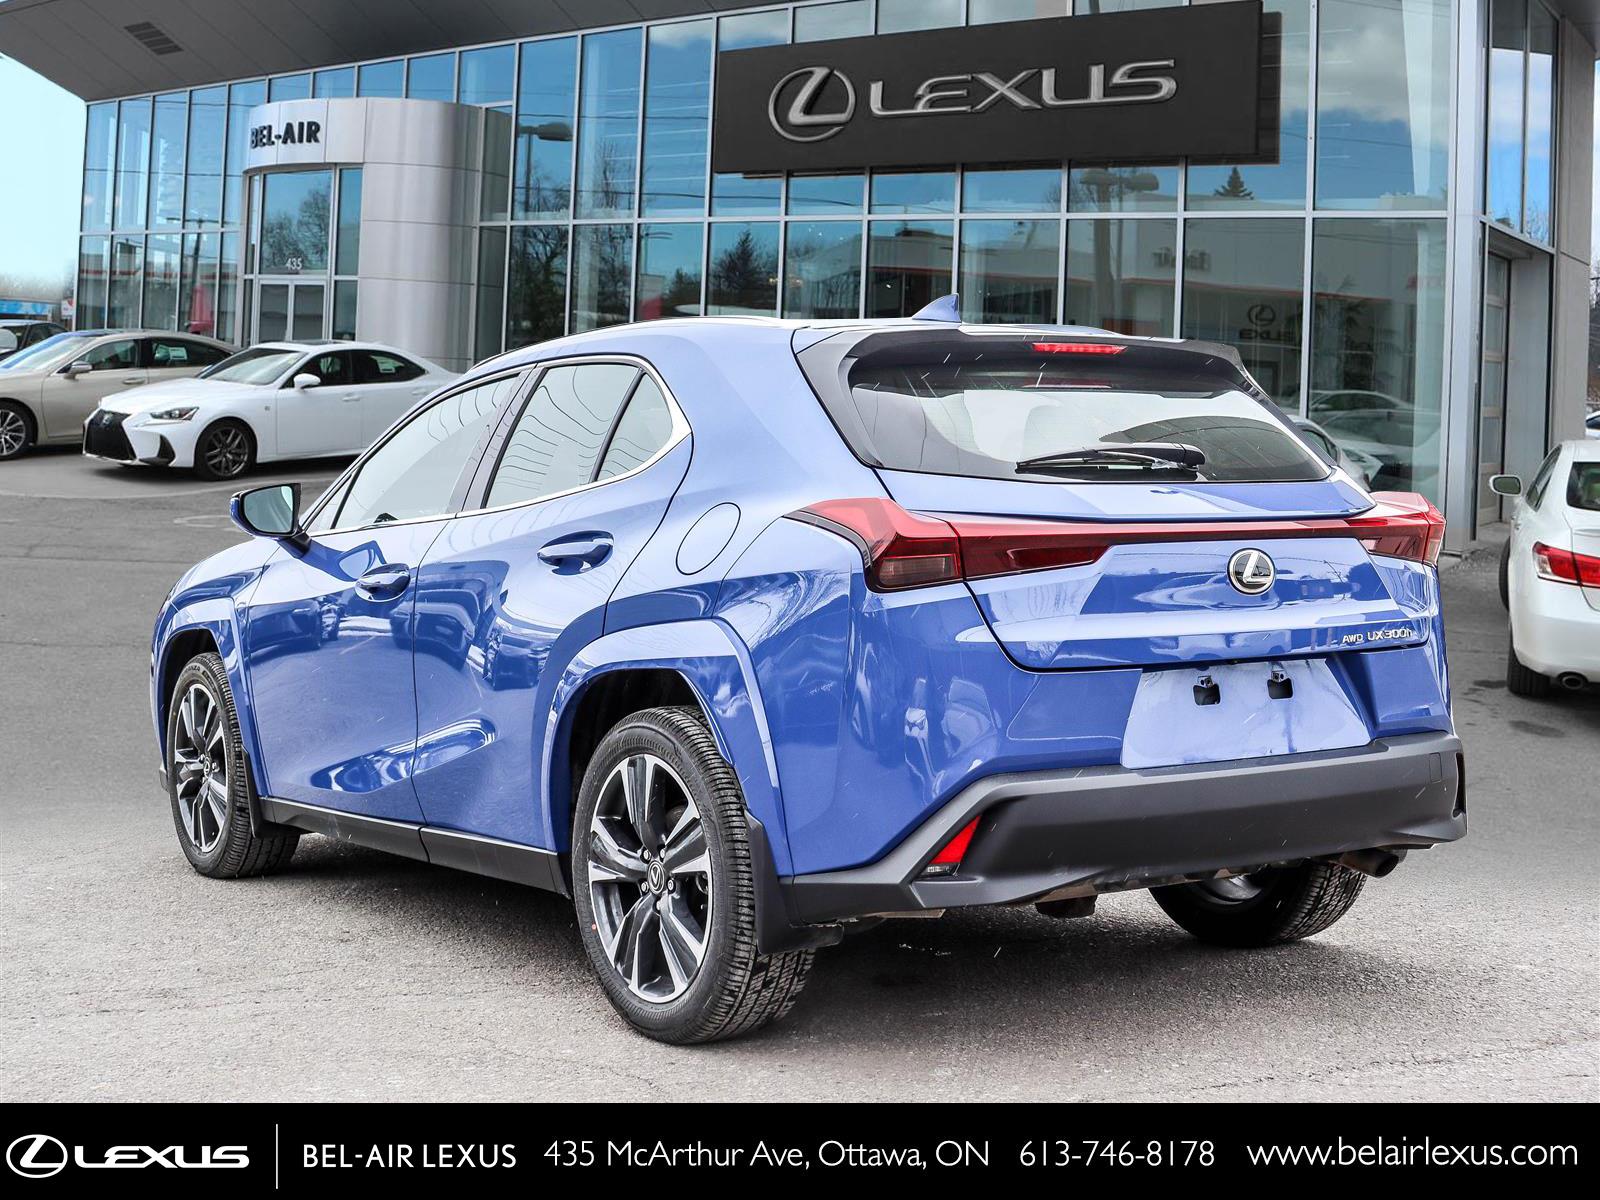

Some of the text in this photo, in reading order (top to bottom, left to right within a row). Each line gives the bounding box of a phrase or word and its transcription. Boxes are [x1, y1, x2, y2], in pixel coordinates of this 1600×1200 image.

[869, 58, 1178, 117] LEXUS
[250, 120, 321, 149] BEL-AIR
[286, 257, 303, 270] 435
[1342, 627, 1413, 644] AWD UX300h
